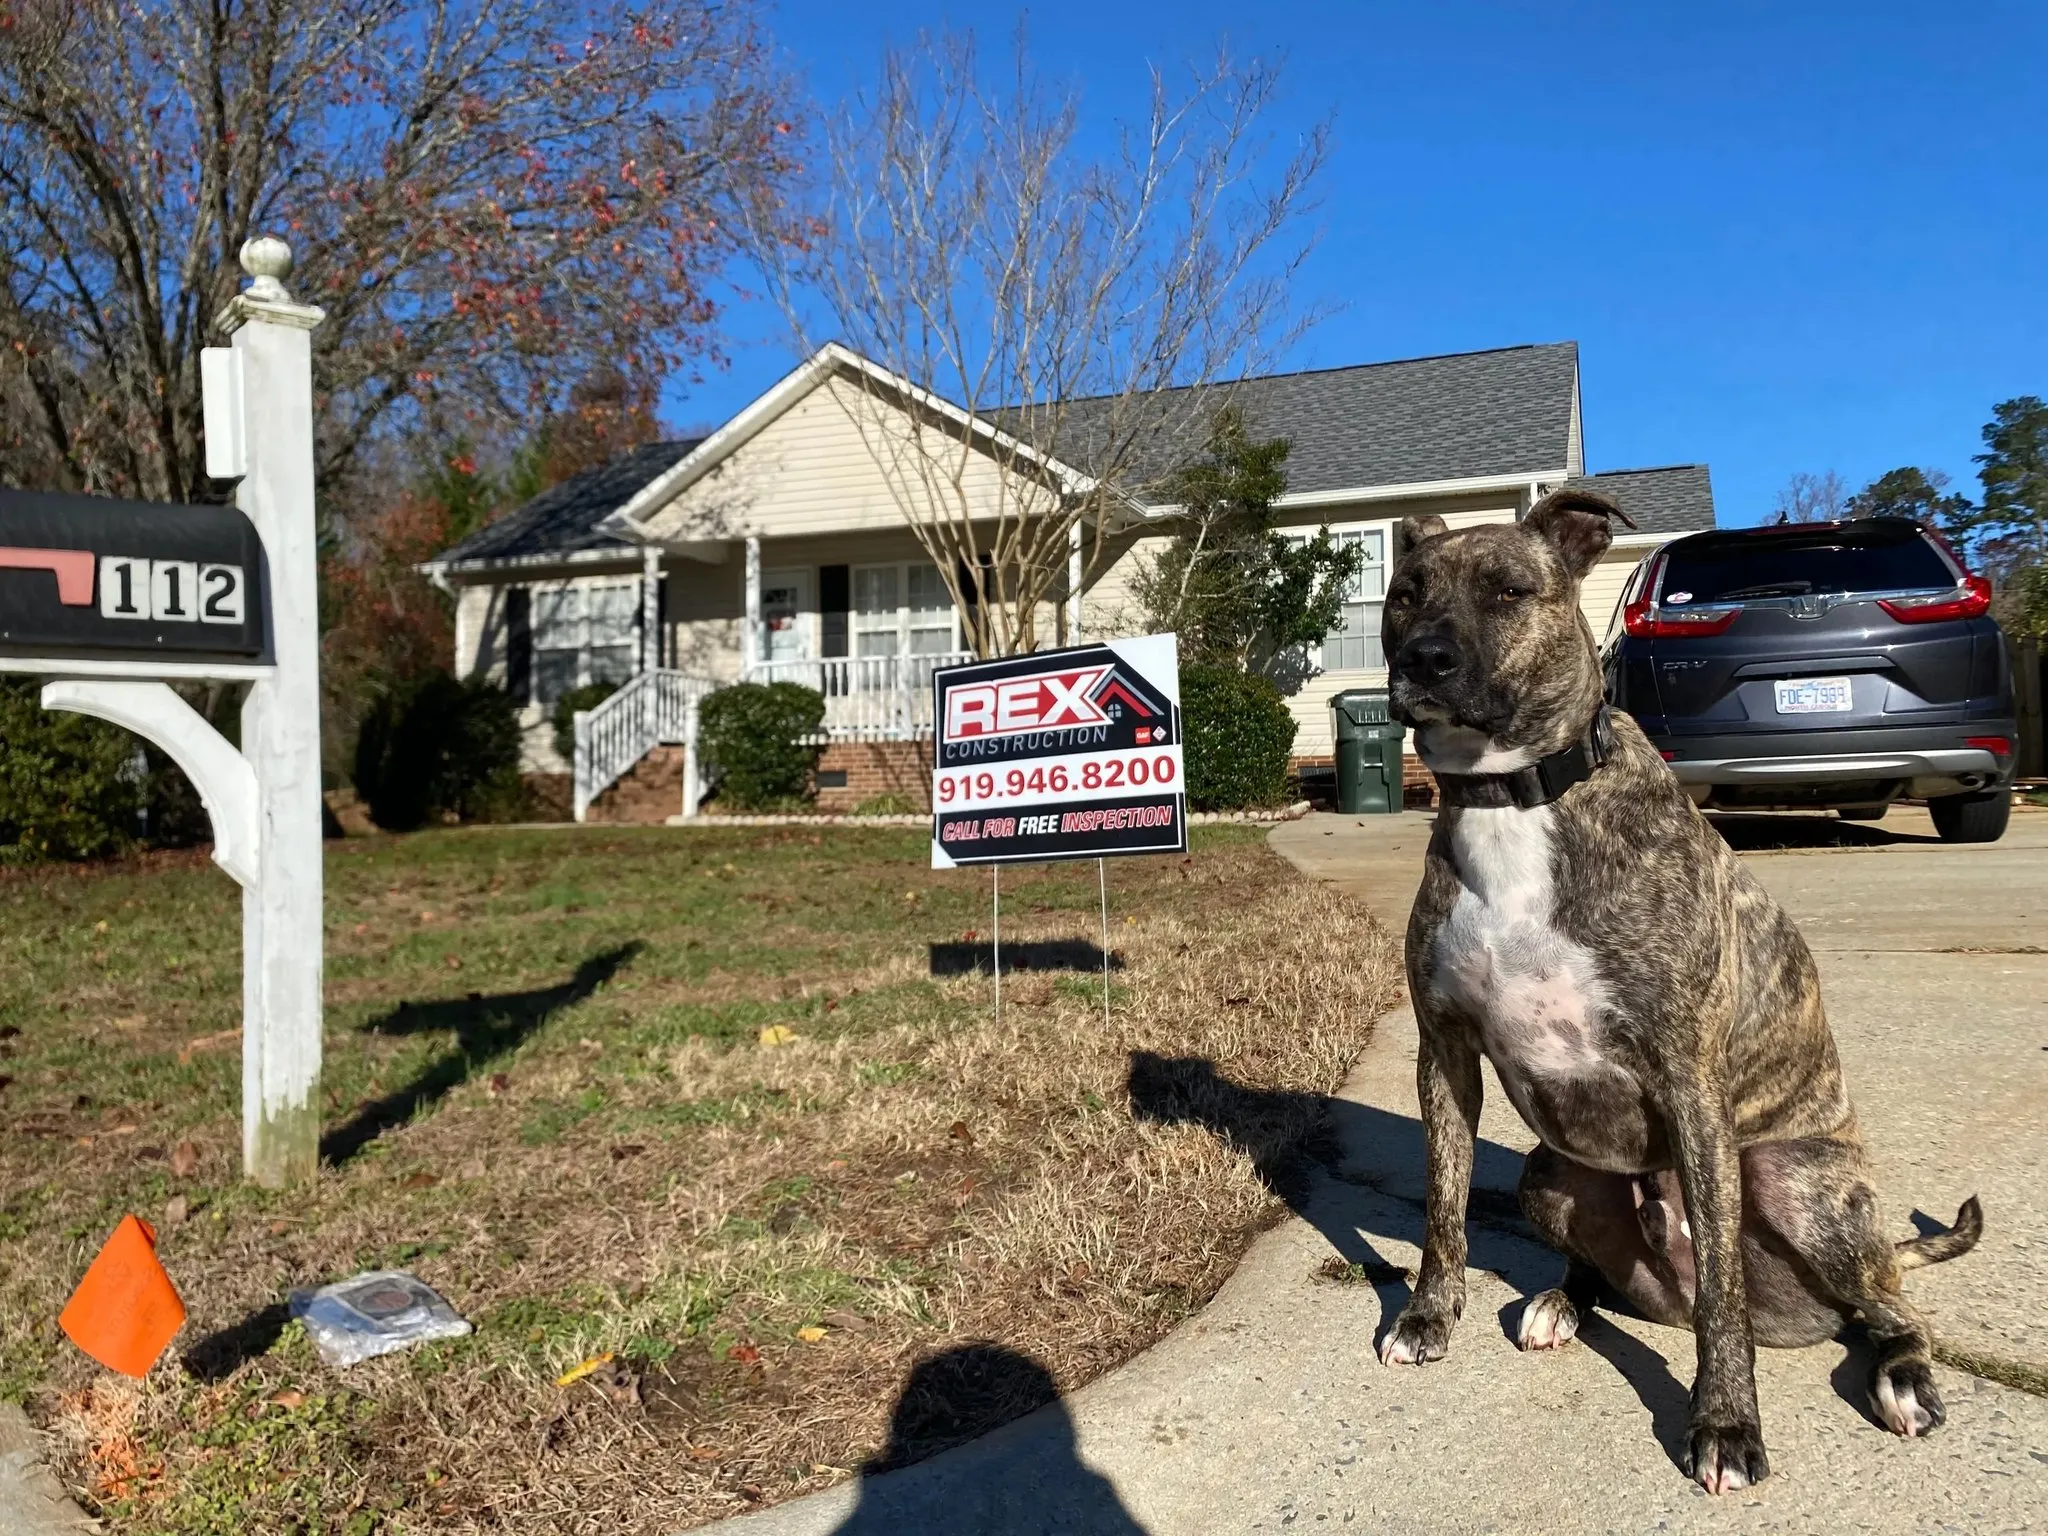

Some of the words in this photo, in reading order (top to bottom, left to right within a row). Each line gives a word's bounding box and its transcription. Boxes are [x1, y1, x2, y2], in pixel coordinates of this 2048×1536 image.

[115, 563, 236, 618] 112
[945, 667, 1109, 742] REX
[946, 726, 1108, 760] CONSTRUCTION
[938, 755, 1176, 803] 919.946.8200
[942, 820, 980, 842] CALL
[982, 817, 1016, 839] FOR
[1017, 814, 1059, 836] FREE
[1060, 805, 1172, 833] INSPECTION
